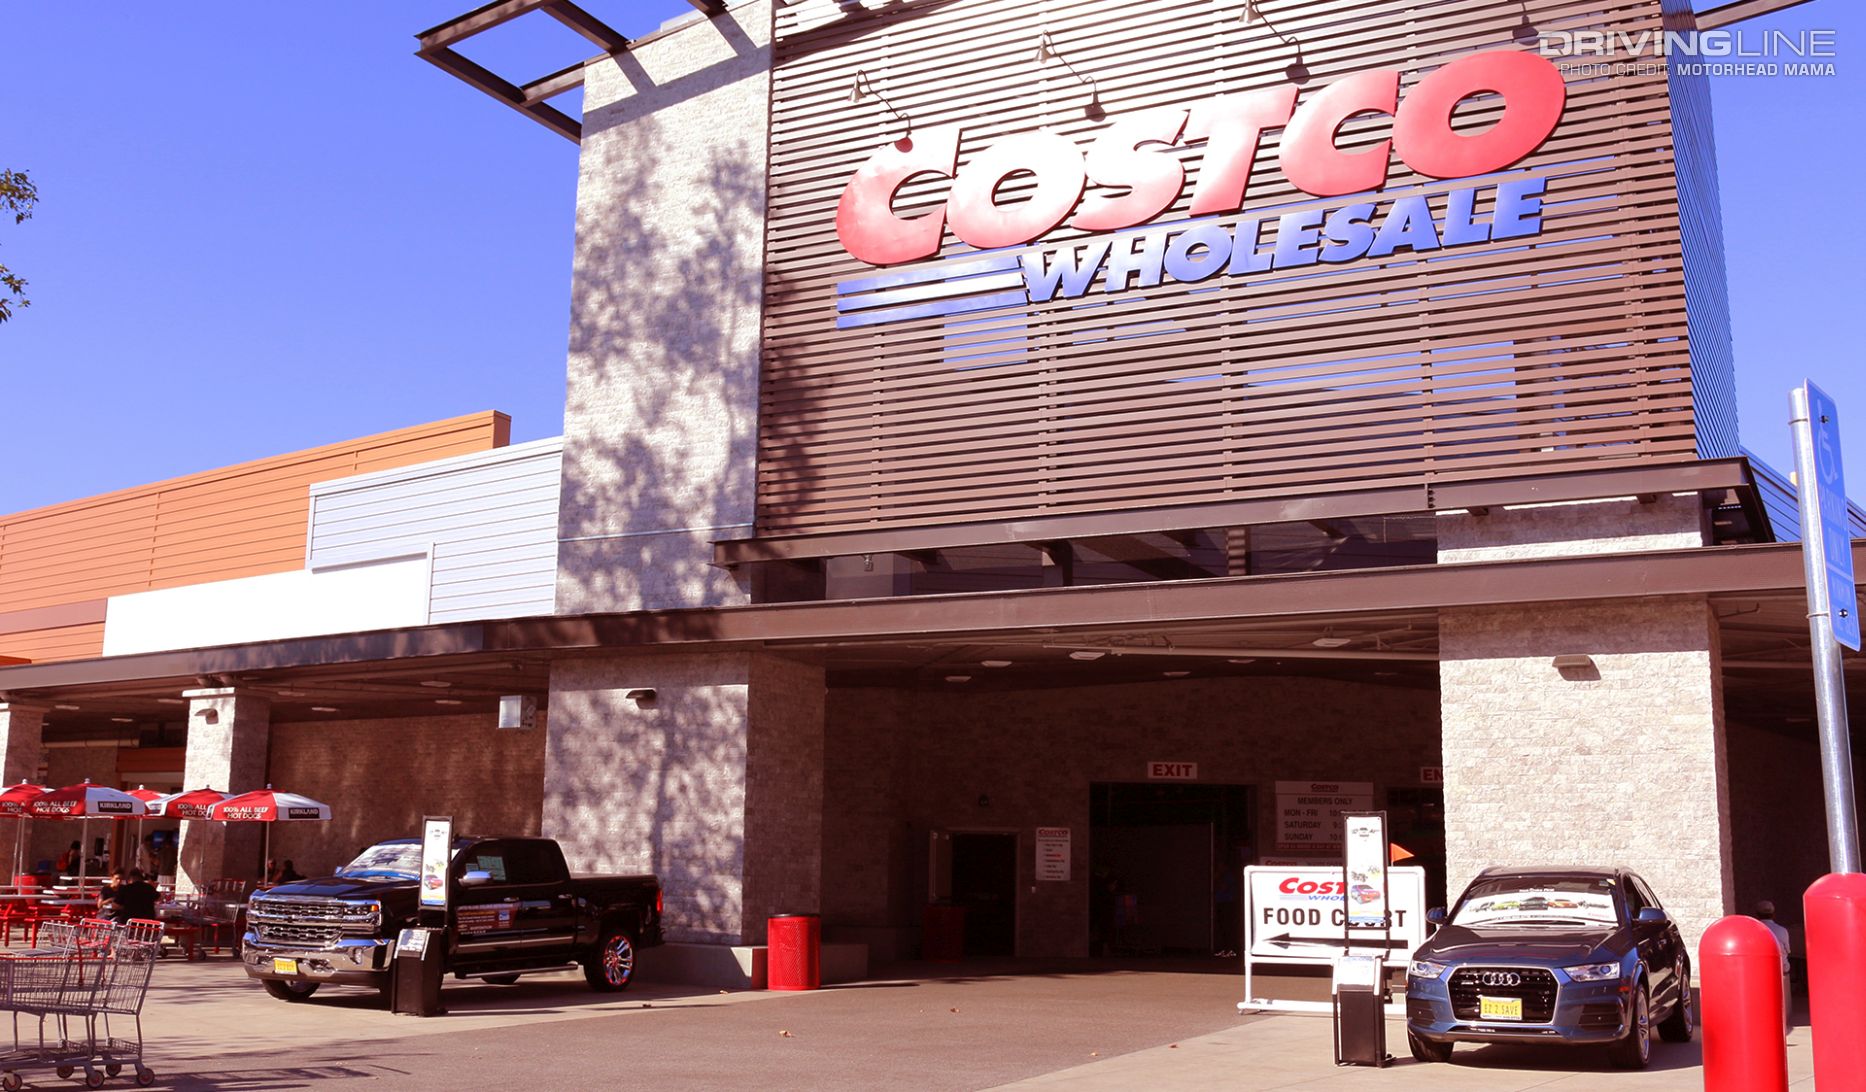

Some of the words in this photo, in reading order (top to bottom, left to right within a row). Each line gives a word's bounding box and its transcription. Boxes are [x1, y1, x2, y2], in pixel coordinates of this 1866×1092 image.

[836, 49, 1567, 266] COSTCO
[1019, 176, 1548, 302] WHOLESALE
[1152, 763, 1193, 777] EXIT
[99, 802, 132, 810] KIRKLAND
[1297, 797, 1333, 805] MEMBERS
[1334, 797, 1352, 805] ONLY
[1284, 821, 1321, 829] SATURDAY
[1284, 833, 1313, 841] SUNDAY
[1263, 908, 1321, 926] FOOD
[1494, 1004, 1499, 1014] 2
[1501, 1004, 1518, 1015] SAVE
